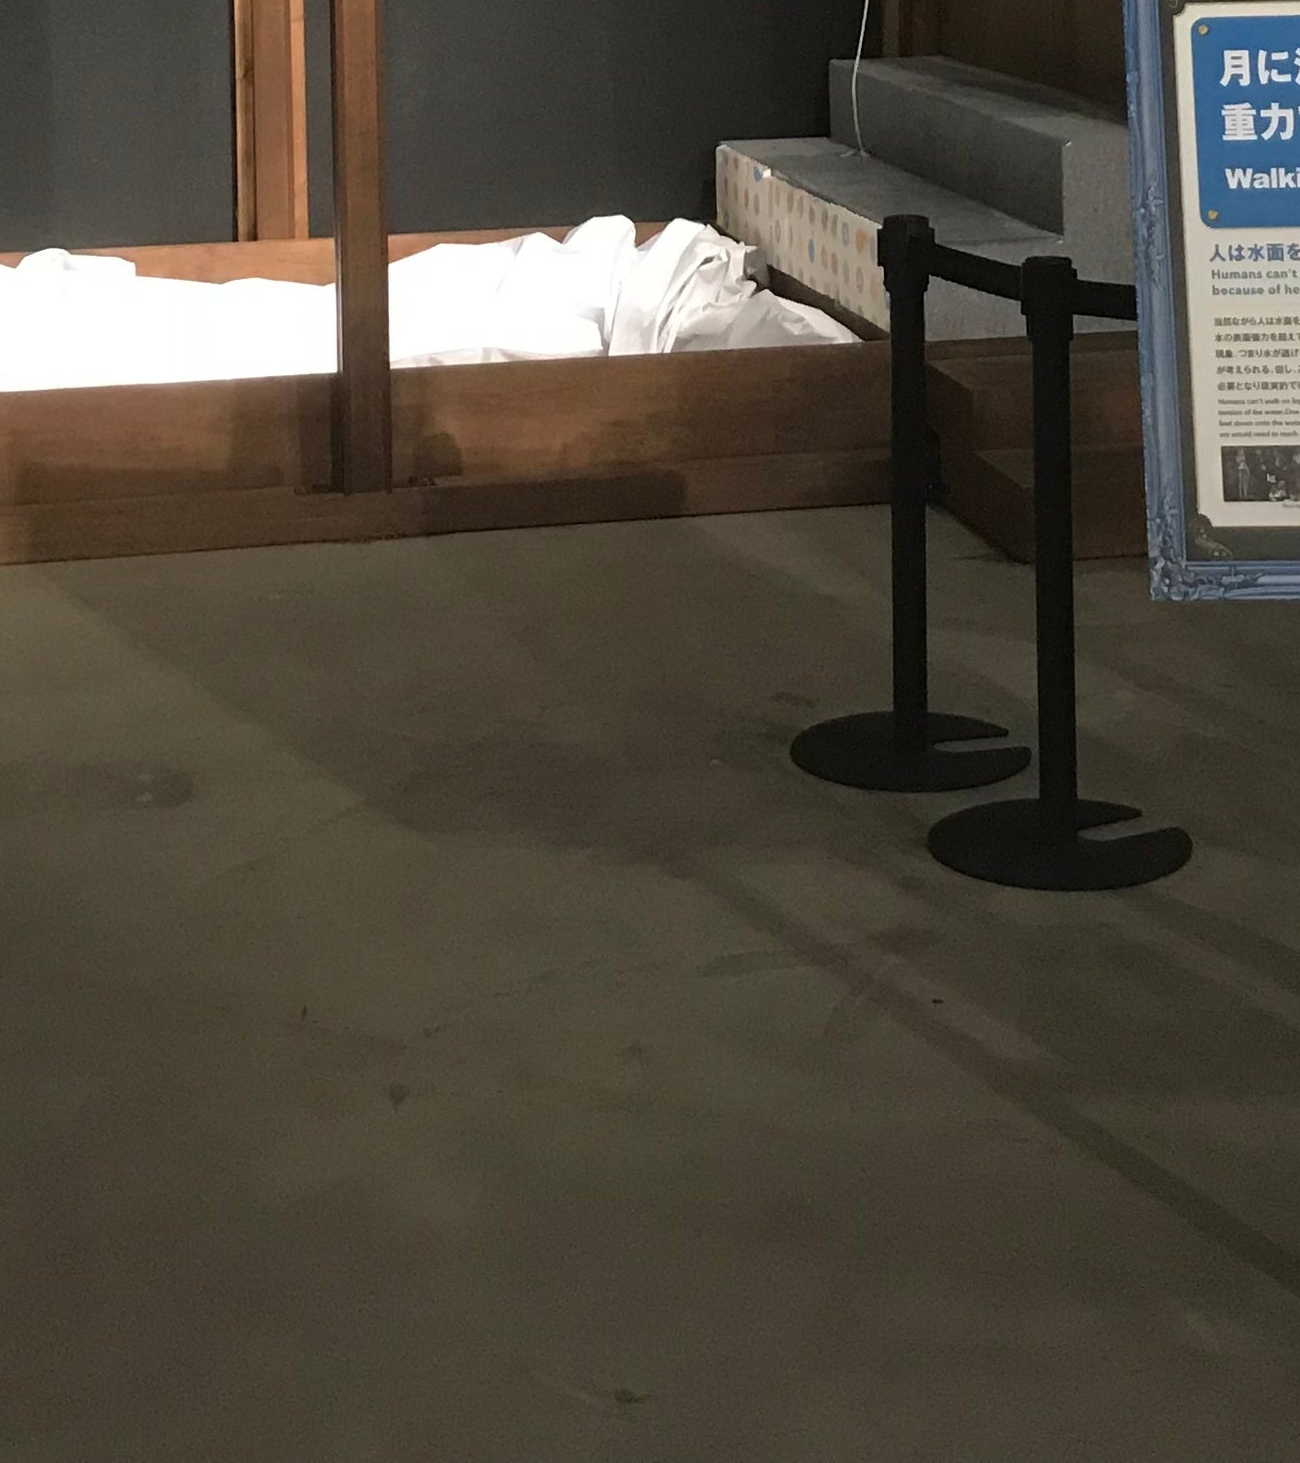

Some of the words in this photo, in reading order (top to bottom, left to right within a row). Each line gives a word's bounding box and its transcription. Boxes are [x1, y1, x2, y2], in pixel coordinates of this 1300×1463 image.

[1212, 270, 1262, 279] Humans
[1212, 285, 1264, 295] because
[1268, 284, 1281, 295] of
